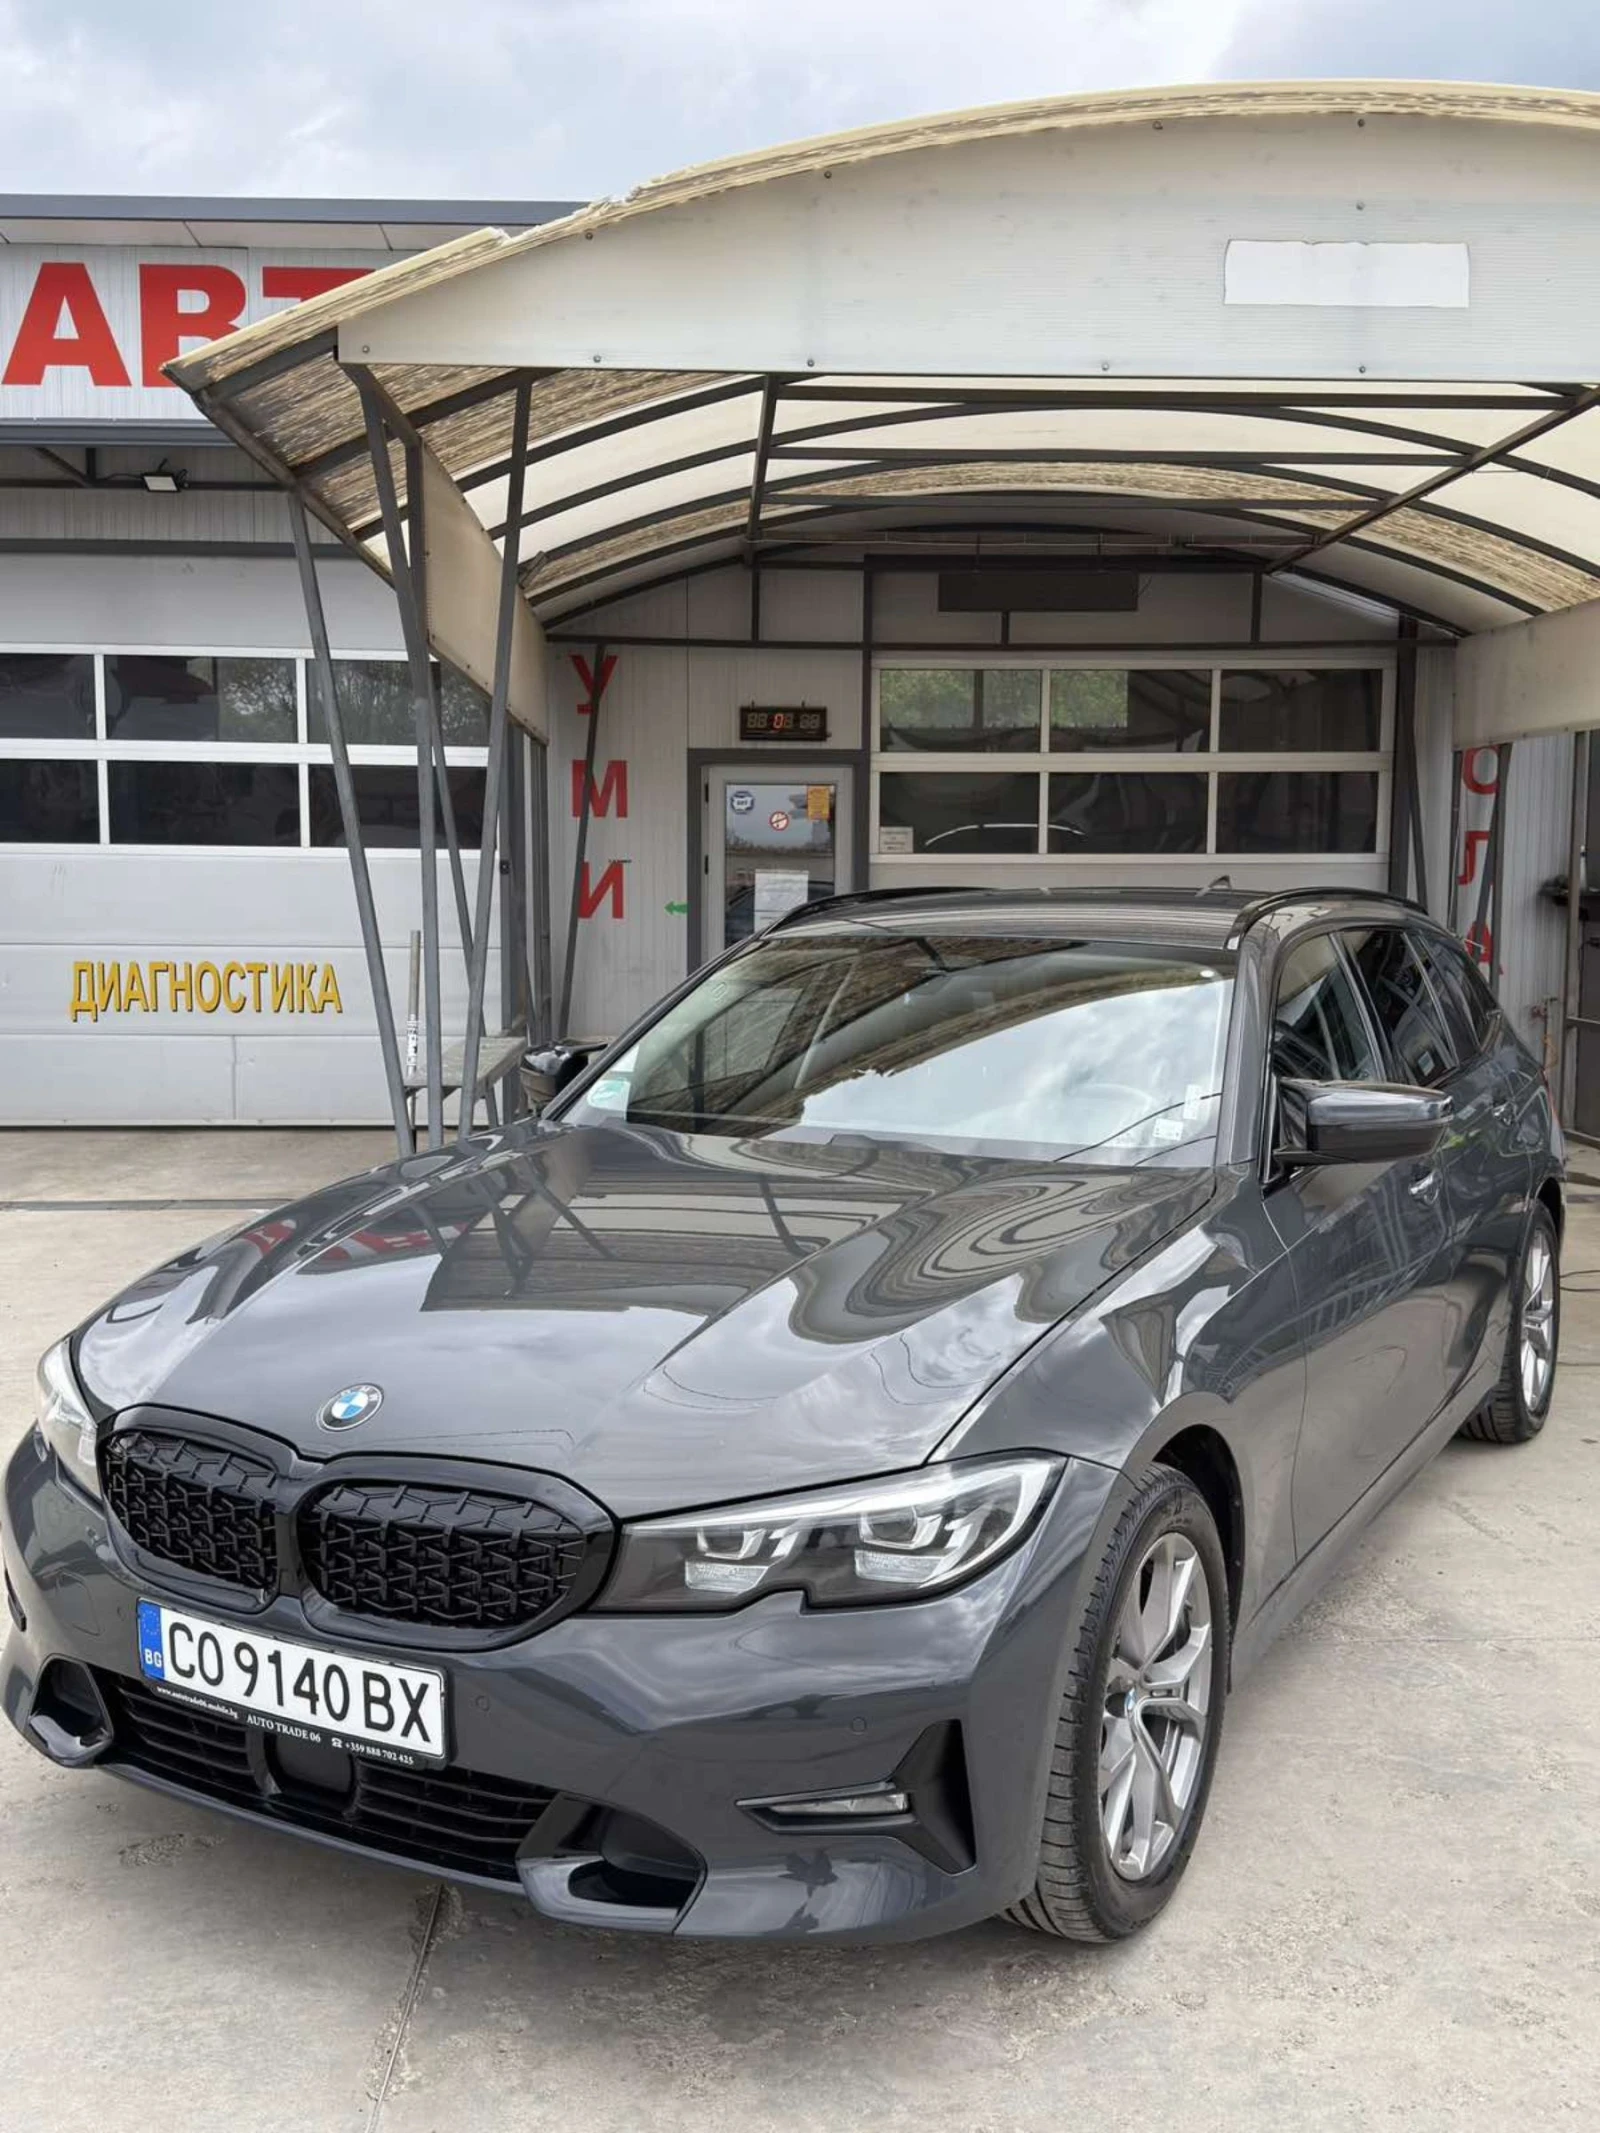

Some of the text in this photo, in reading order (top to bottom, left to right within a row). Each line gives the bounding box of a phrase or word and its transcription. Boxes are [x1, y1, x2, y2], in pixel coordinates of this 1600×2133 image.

[70, 961, 343, 1022] ДИАГНОСТИКА
[145, 1648, 163, 1668] BG
[169, 1622, 431, 1743] CO 9140 BX
[246, 1714, 321, 1743] AUTO TRADE 06
[345, 1741, 365, 1753] +359
[382, 1749, 398, 1761] 702
